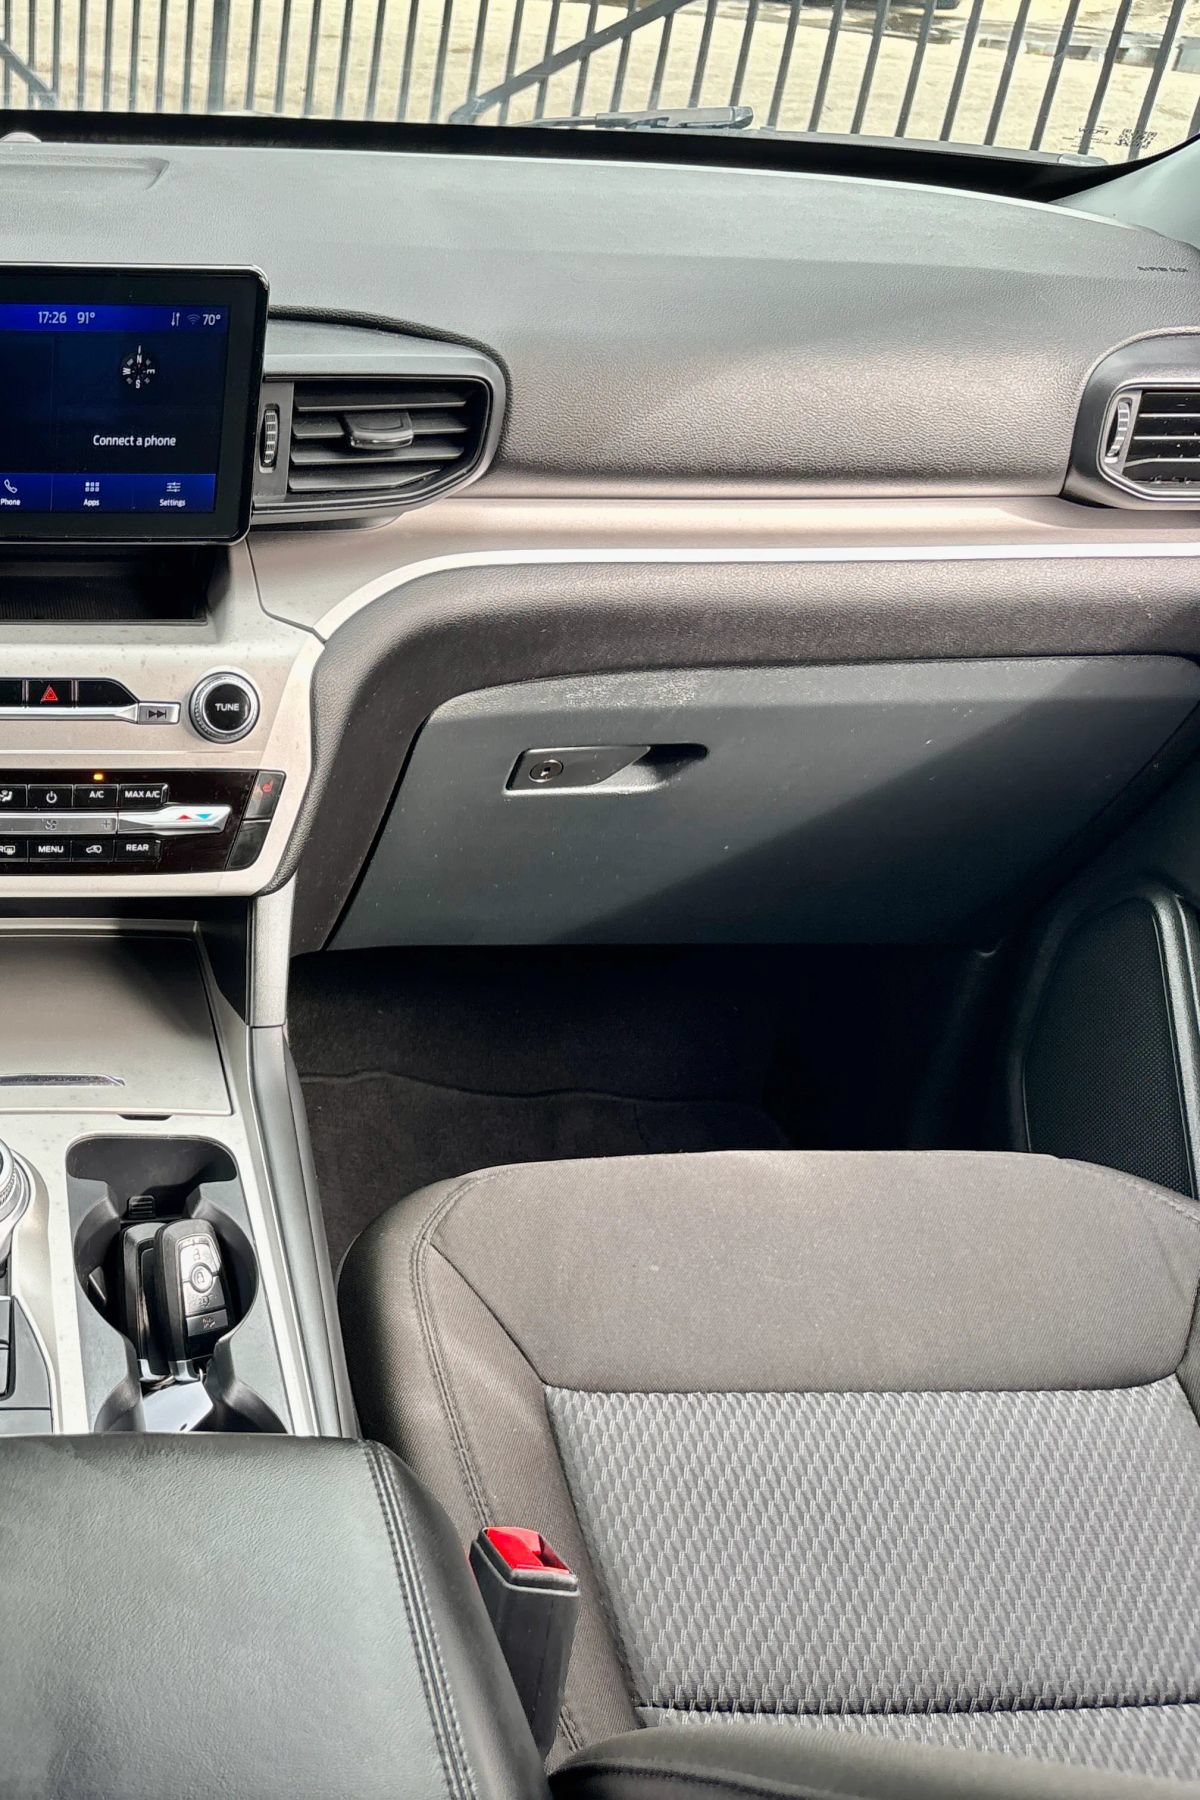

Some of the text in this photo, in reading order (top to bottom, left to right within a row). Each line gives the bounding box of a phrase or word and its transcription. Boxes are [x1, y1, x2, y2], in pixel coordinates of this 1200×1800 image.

[37, 311, 96, 324] 17:26 91°
[202, 314, 222, 326] 70°
[92, 434, 177, 448] Connect a phone
[0, 498, 21, 506] Phone
[83, 498, 100, 507] Apps
[159, 498, 186, 508] Settings
[214, 703, 240, 712] TUNE
[88, 789, 105, 799] A/C
[124, 790, 161, 799] MAX A/C
[38, 845, 64, 853] MENU
[125, 843, 149, 852] REAR
